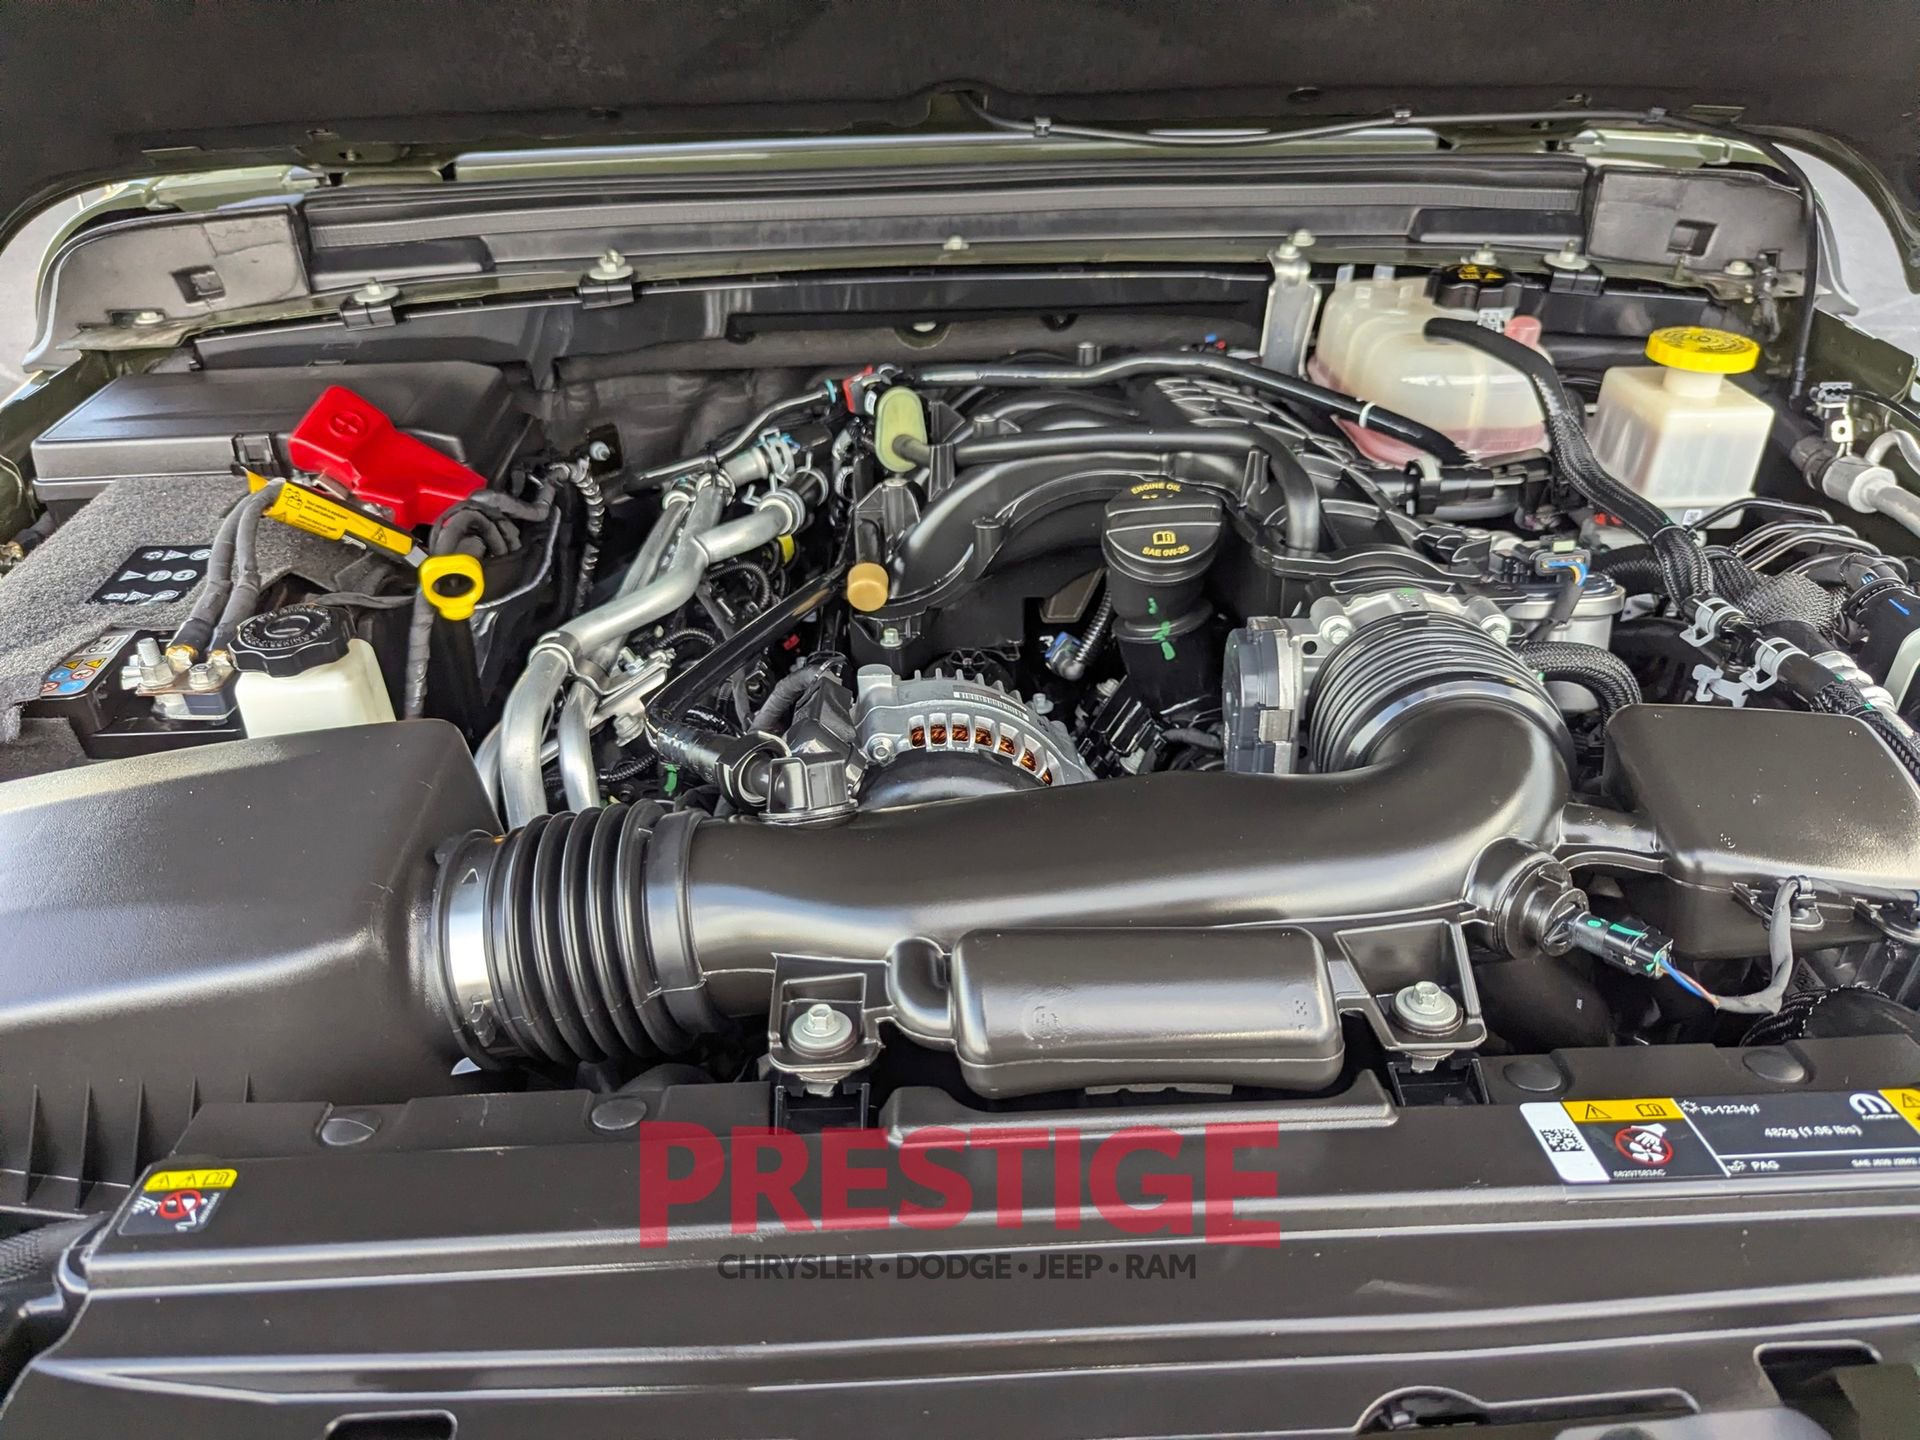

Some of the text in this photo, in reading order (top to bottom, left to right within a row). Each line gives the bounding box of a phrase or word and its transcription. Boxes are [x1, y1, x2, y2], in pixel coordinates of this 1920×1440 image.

[1130, 481, 1182, 494] ENGINE OIL
[1142, 546, 1162, 556] SAE
[1751, 1160, 1780, 1171] PAG
